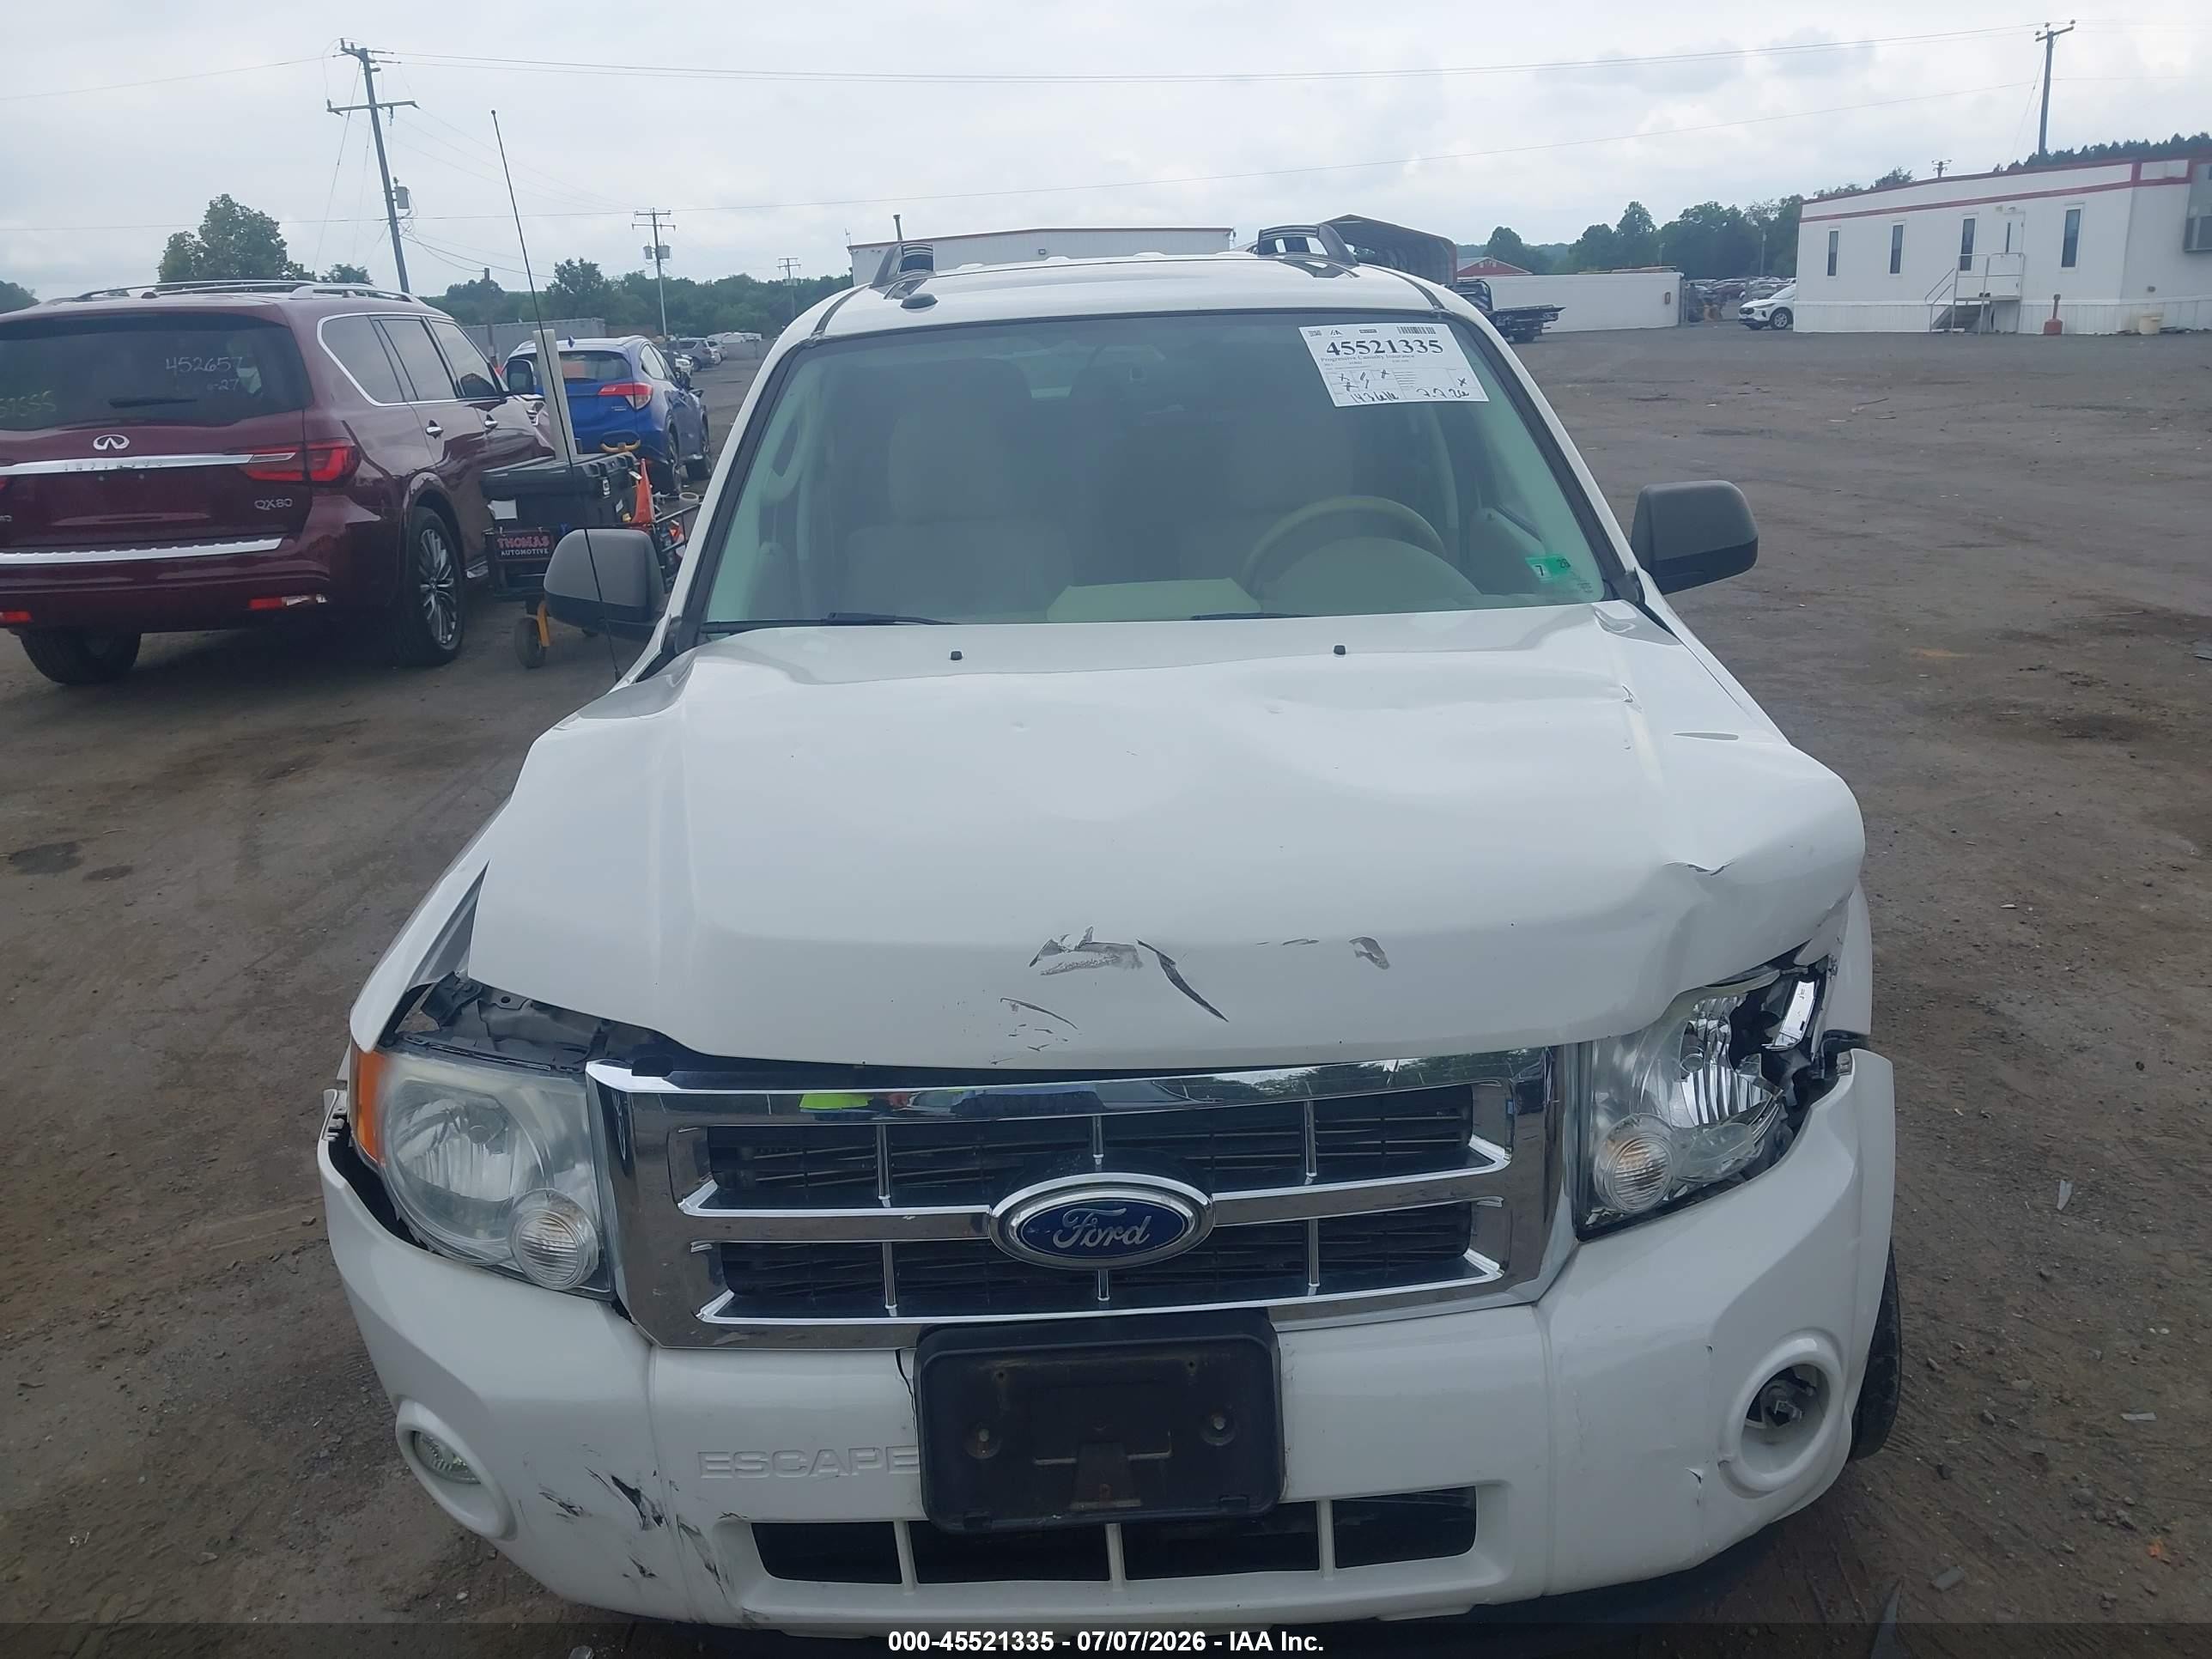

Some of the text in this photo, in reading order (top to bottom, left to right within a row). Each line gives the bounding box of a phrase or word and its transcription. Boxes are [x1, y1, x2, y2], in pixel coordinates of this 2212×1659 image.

[1326, 339, 1443, 356] 45521335
[254, 498, 293, 511] QX80
[497, 535, 550, 550] THOMAS
[1053, 1207, 1152, 1249] Ford
[696, 1445, 920, 1479] ESCAPE
